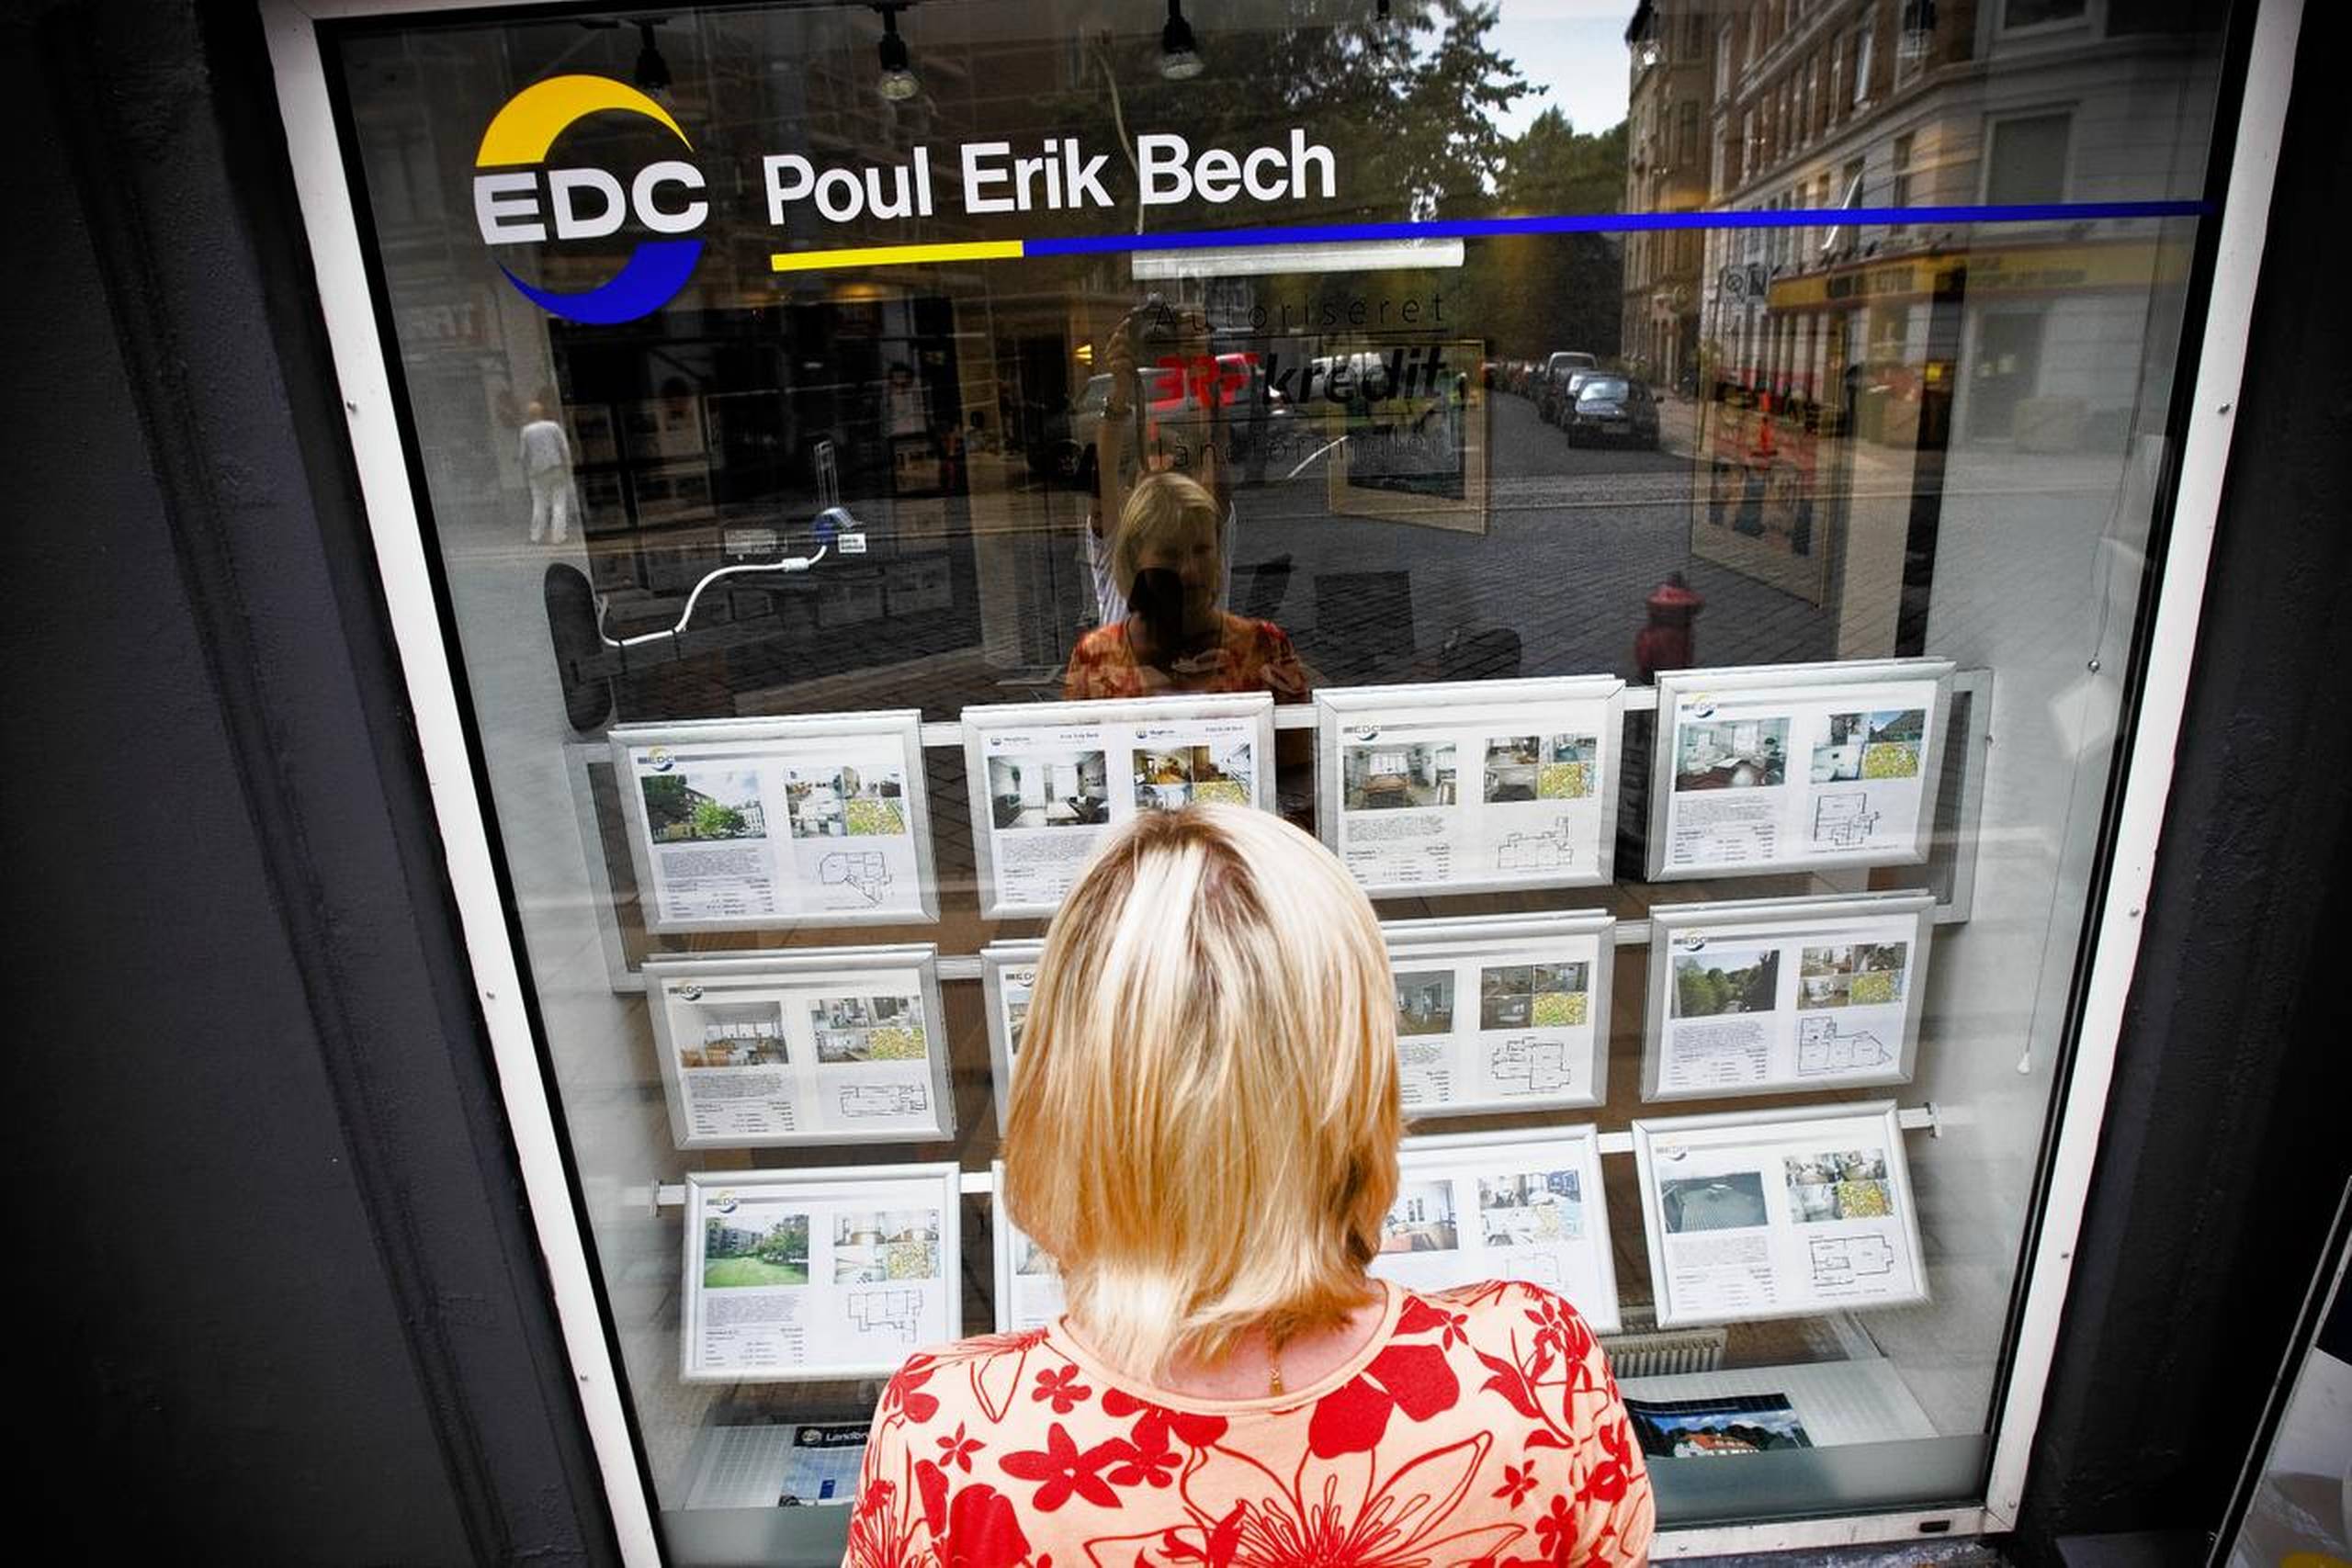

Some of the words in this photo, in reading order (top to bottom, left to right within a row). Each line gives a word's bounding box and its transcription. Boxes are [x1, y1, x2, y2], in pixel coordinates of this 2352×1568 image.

[473, 161, 708, 245] EDC
[763, 146, 933, 226] Poul
[961, 138, 1114, 214] Erik
[1137, 130, 1337, 207] Bech
[1153, 292, 1445, 333] Autoriseret
